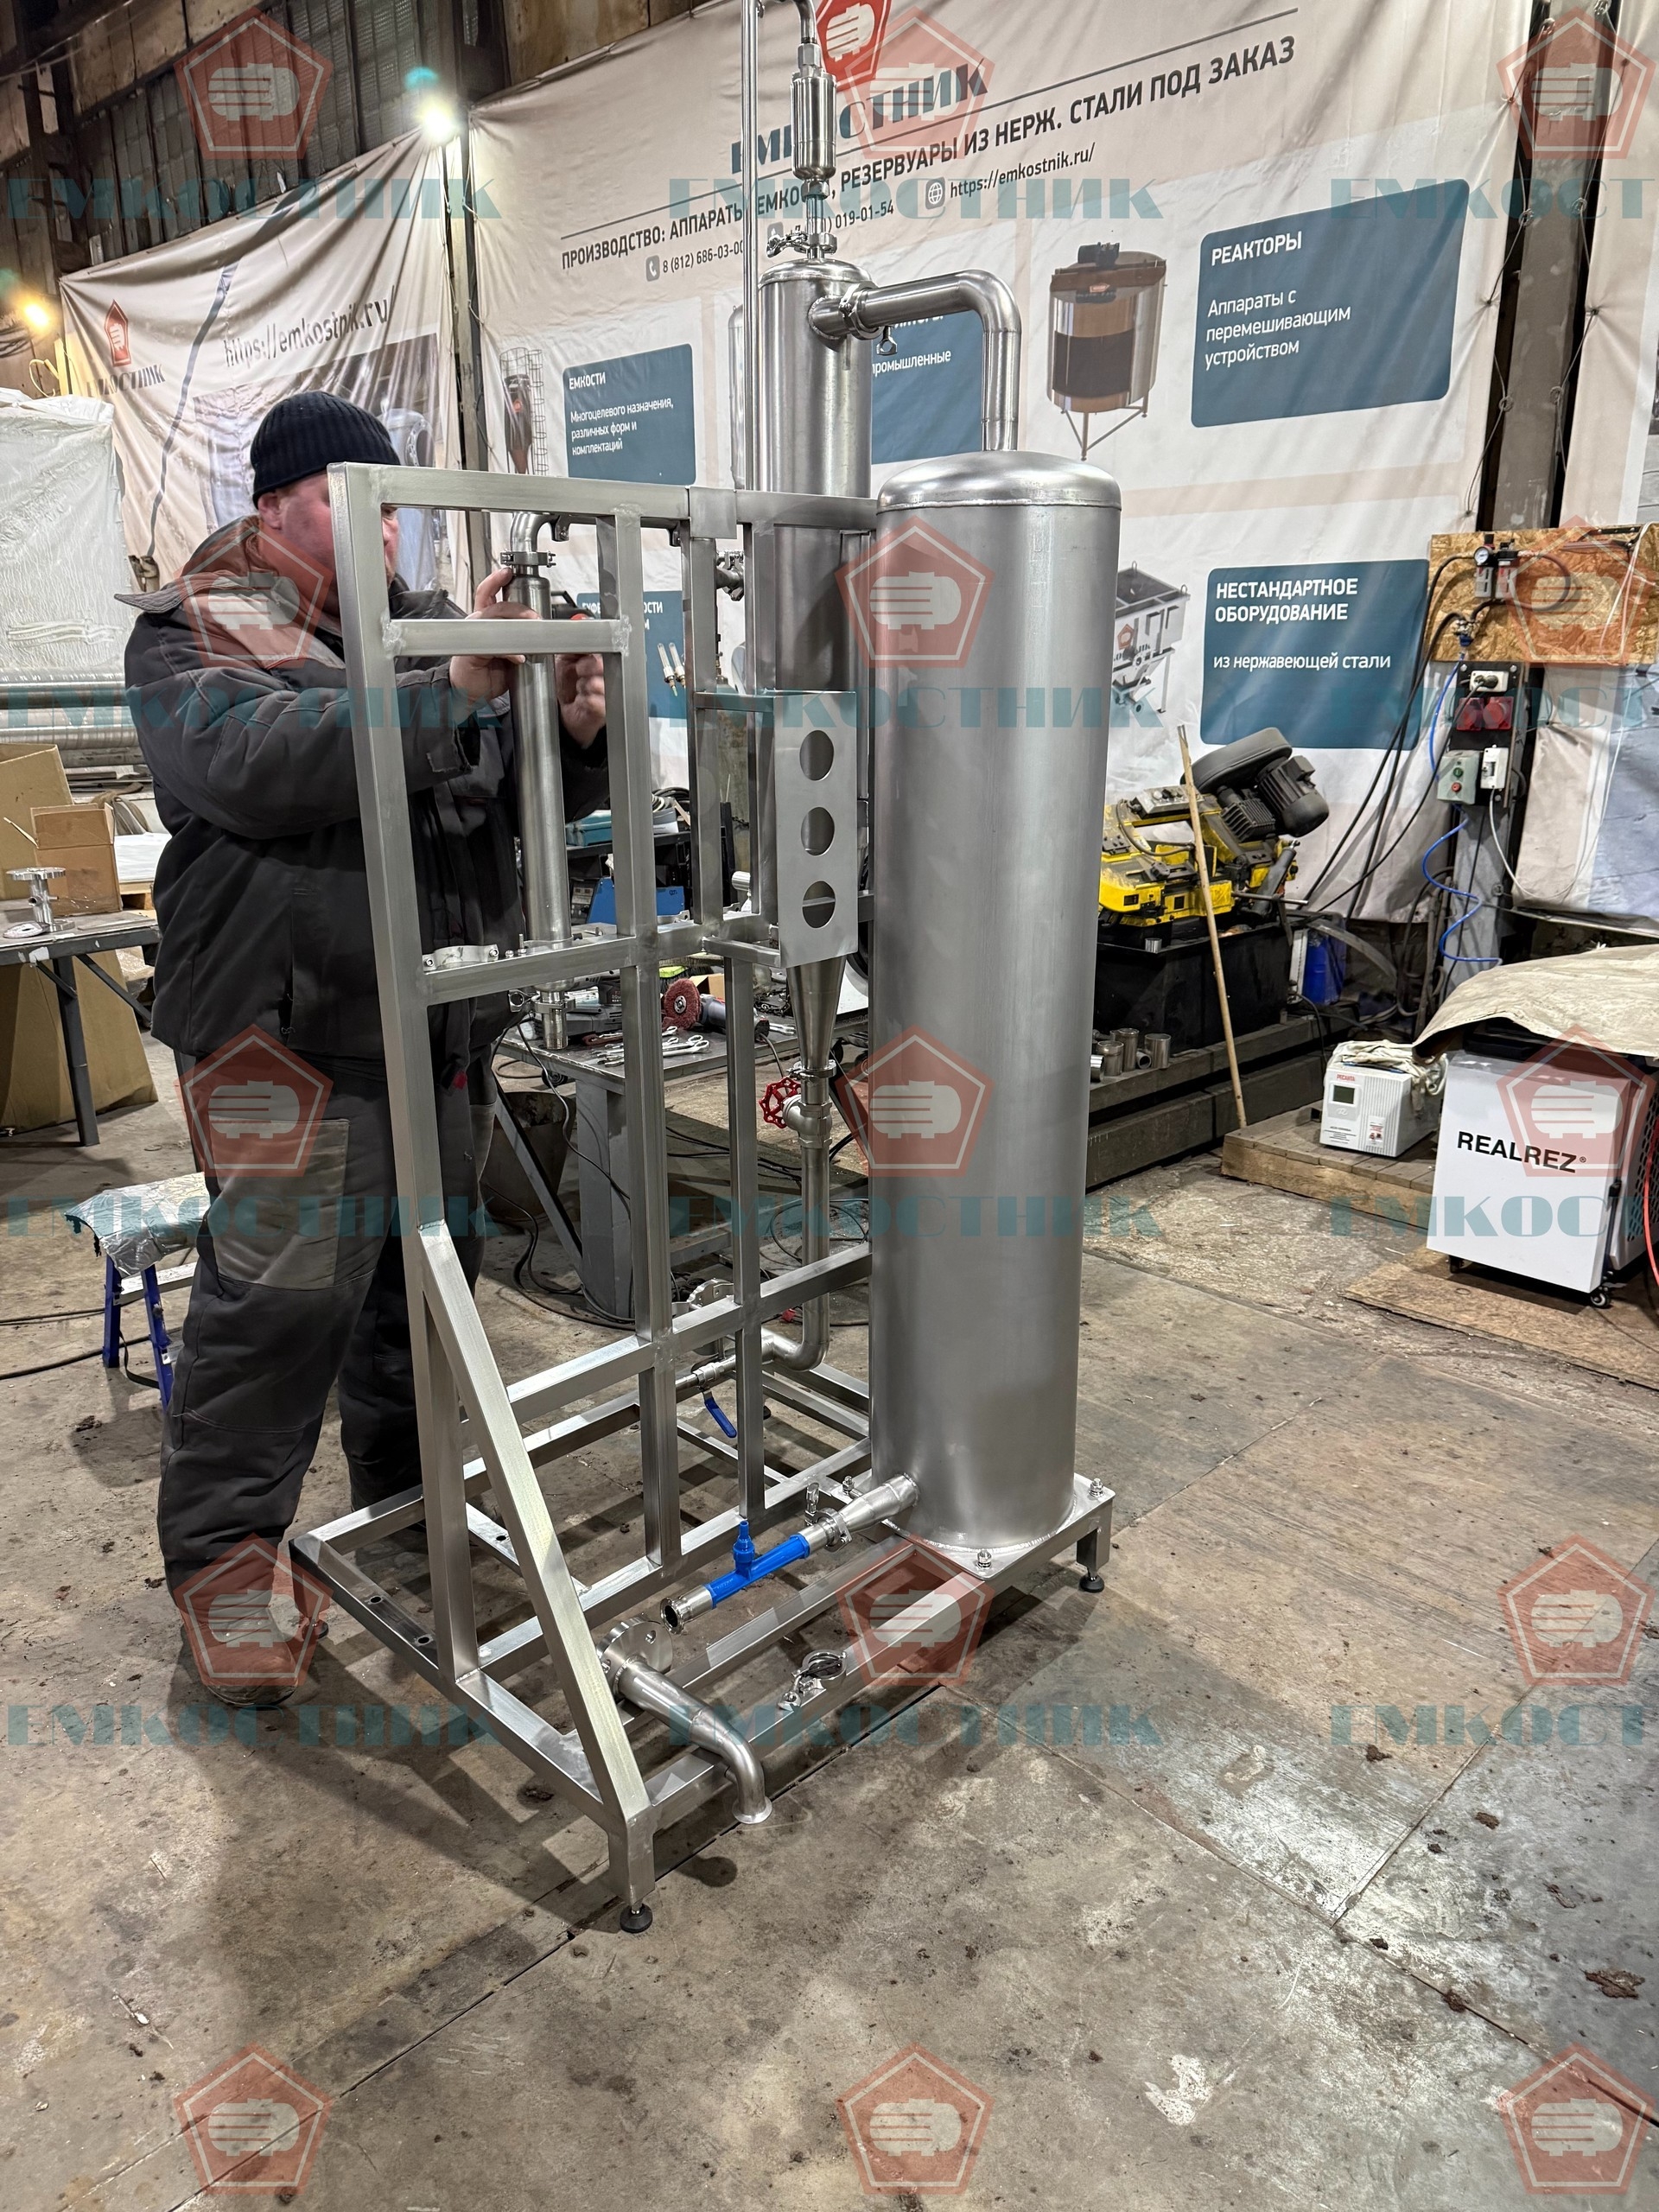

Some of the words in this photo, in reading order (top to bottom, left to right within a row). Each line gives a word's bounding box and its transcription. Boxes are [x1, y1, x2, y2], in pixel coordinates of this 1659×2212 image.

[562, 226, 665, 269] ПРОИЗВОДСТВО:
[841, 137, 957, 191] РЕЗЕРВУАРЫ
[964, 128, 988, 156] ИЗ
[995, 107, 1062, 146] НЕРЖ.
[1070, 80, 1142, 124] СТАЛИ
[1150, 63, 1200, 98] ПОД
[1208, 35, 1295, 84] ЗАКАЗ
[950, 142, 1096, 198] https://emkostnik.ru/
[835, 200, 894, 229] 019-01-54
[1211, 231, 1302, 266] РЕАКТОРЫ
[663, 260, 669, 272] 8
[671, 252, 694, 273] (812)
[1207, 291, 1284, 317] Аппараты
[1288, 289, 1297, 303] с
[1206, 306, 1351, 344] перемешивающим
[1205, 340, 1300, 371] устройством
[569, 372, 607, 390] ЕМКОСТИ
[570, 406, 626, 423] Многоцелевого
[626, 397, 674, 414] назначения,
[571, 425, 609, 442] различных
[610, 422, 631, 436] форм
[632, 421, 638, 430] и
[572, 437, 623, 455] комплектаций
[1216, 578, 1358, 600] НЕСТАНДАРТНОЕ
[1215, 603, 1349, 625] ОБОРУДОВАНИЕ
[1213, 656, 1230, 669] из
[1233, 652, 1338, 672] нержавеющей
[1342, 655, 1391, 669] стали
